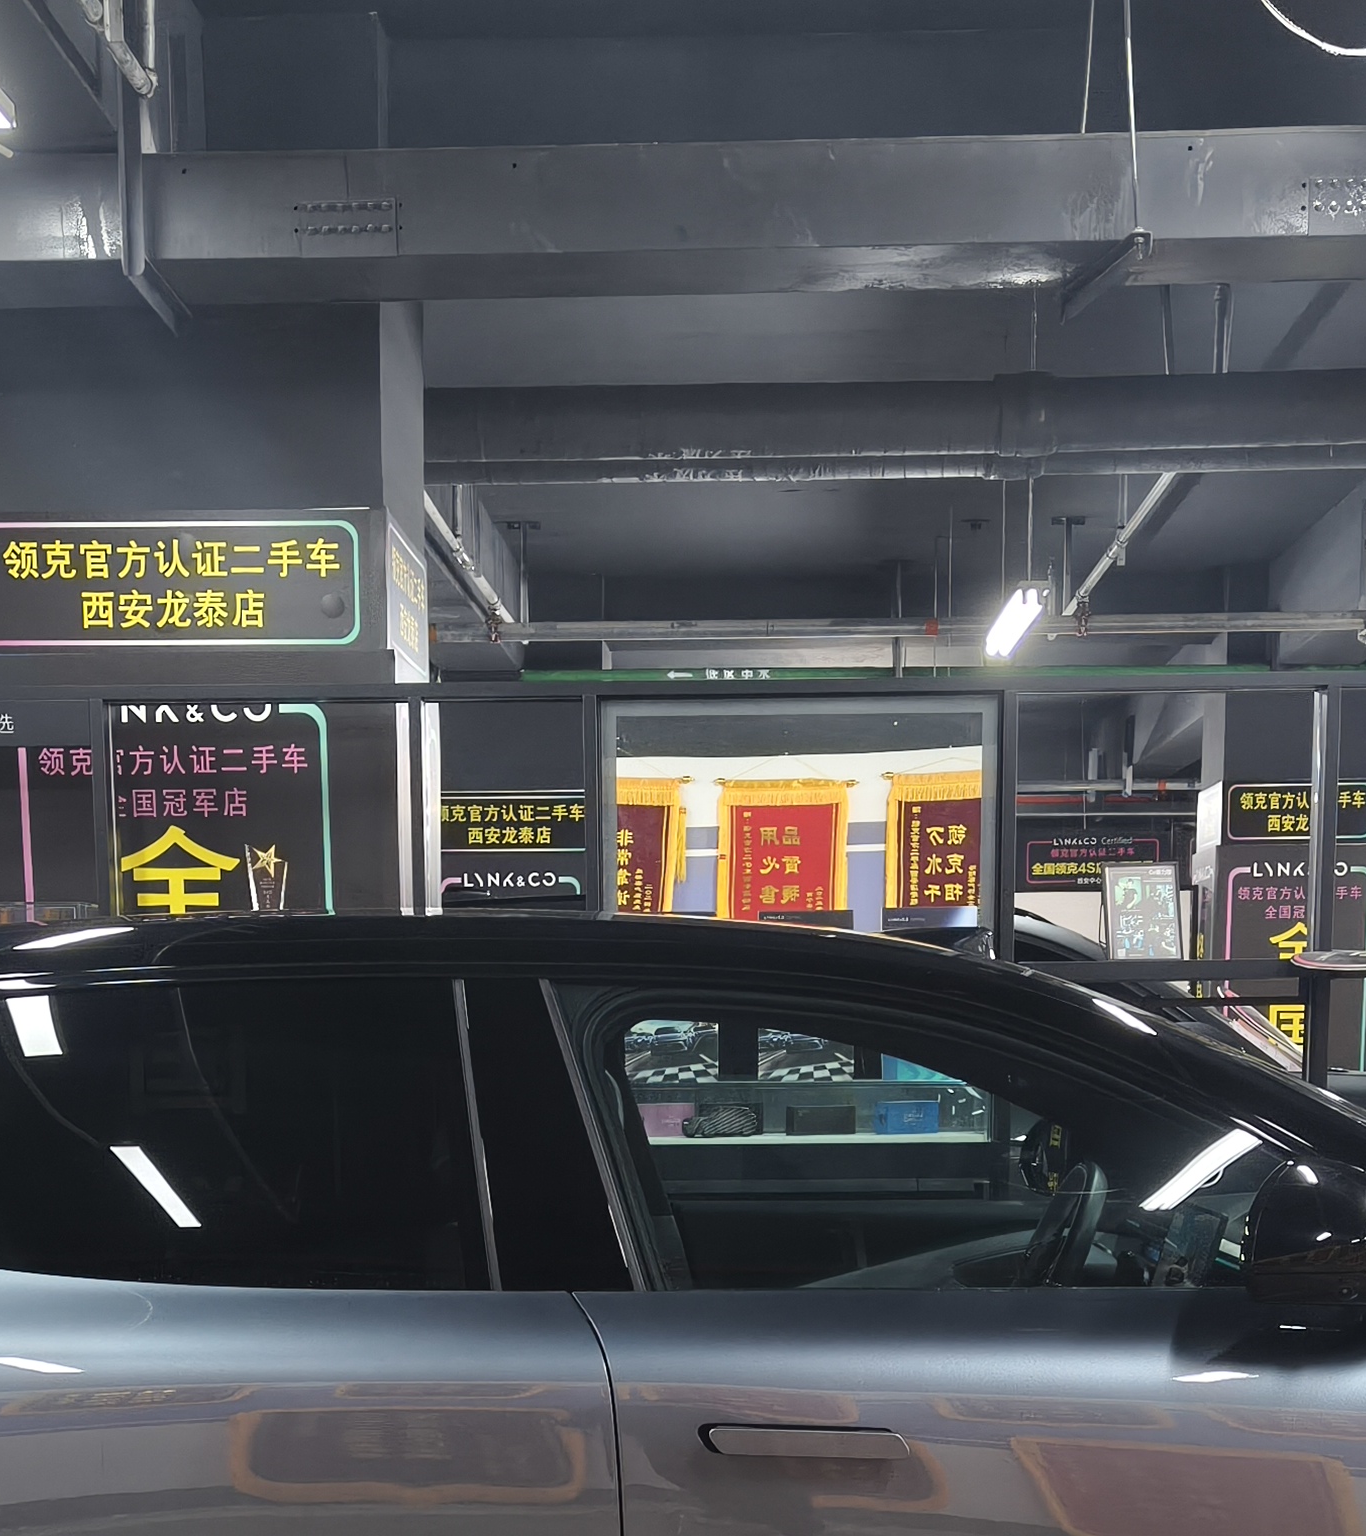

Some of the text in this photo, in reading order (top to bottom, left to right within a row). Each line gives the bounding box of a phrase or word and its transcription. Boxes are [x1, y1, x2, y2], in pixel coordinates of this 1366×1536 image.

[2, 539, 341, 581] 领克官方认证二手车
[80, 590, 267, 630] 西安龙泰店
[1240, 790, 1366, 809] 领克官方认手车
[467, 826, 551, 845] 西安龙泰店
[463, 872, 556, 887] LYNK&CO
